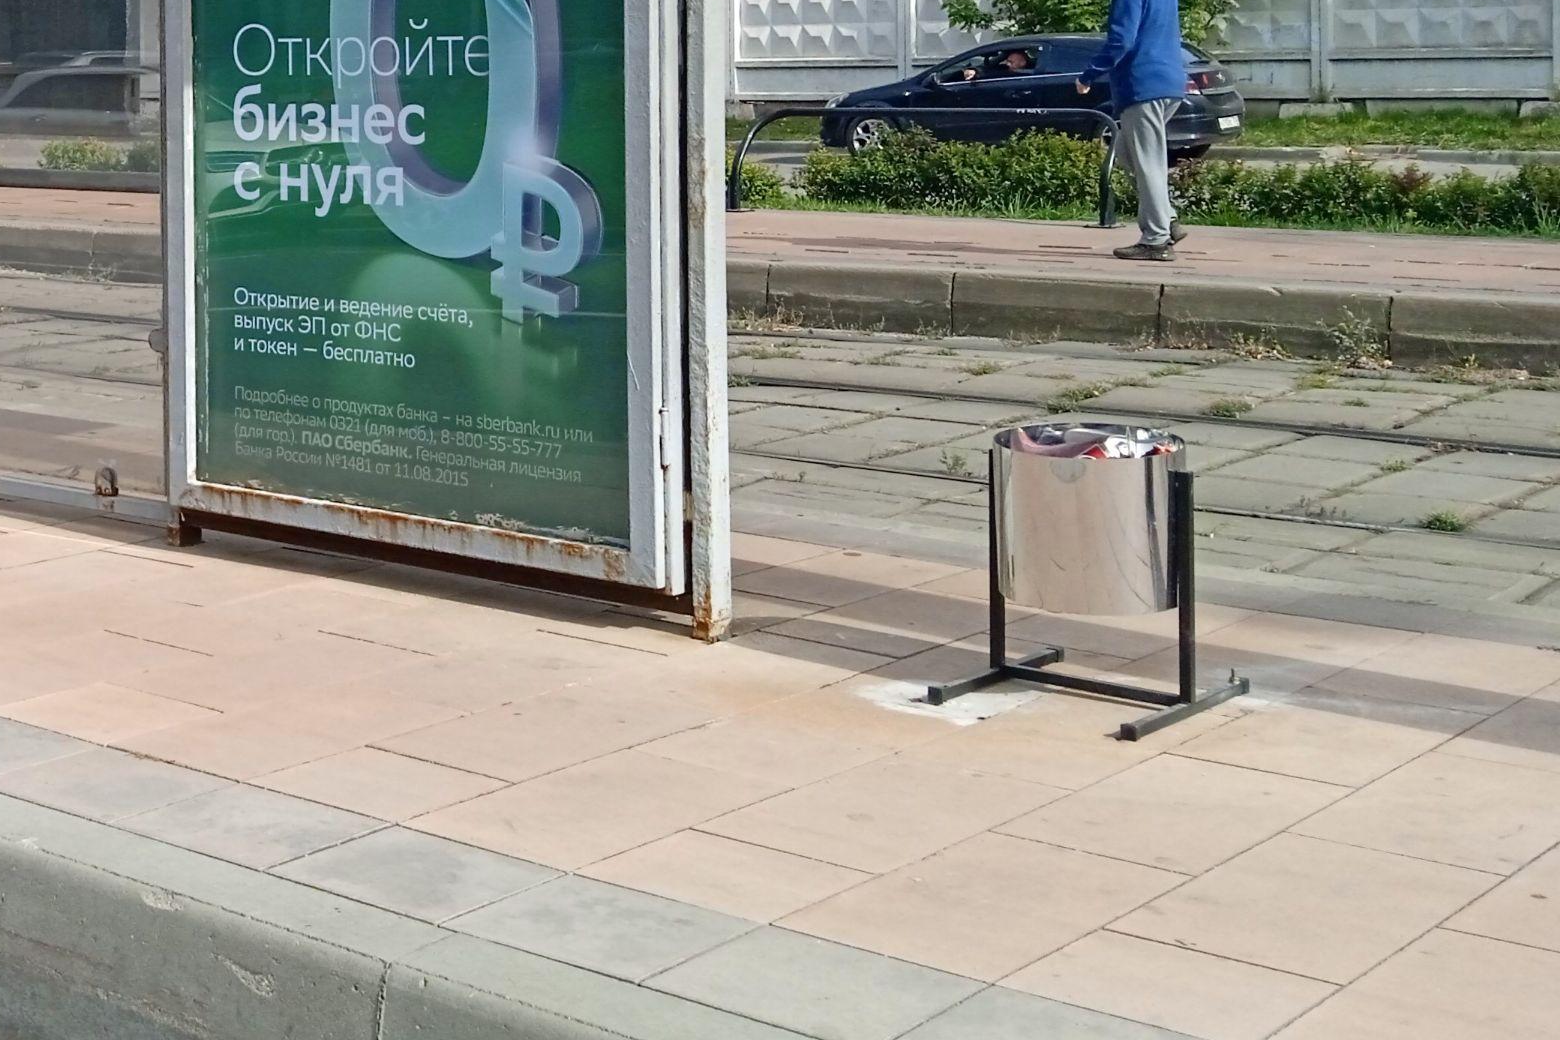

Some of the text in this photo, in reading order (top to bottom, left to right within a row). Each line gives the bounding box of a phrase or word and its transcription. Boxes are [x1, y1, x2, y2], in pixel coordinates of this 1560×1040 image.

[233, 18, 491, 88] Откройте
[233, 84, 425, 145] бизнес
[233, 162, 404, 218] с нуля
[234, 287, 473, 328] Открытие и ведение счёта,
[234, 314, 402, 342] выпуск ЭП от ФНС
[234, 337, 244, 351] и
[248, 338, 297, 356] токен
[323, 340, 416, 368] бесплатно
[234, 386, 309, 408] Подробнее
[312, 396, 321, 409] о
[324, 398, 394, 418] продуктах
[397, 403, 438, 423] банка
[455, 414, 473, 428] на
[476, 413, 560, 439] sberbank.ru
[564, 428, 594, 443] или
[234, 407, 251, 420] по
[253, 408, 327, 428] телефонам
[329, 415, 360, 433] 0321
[364, 419, 395, 438] (для
[440, 429, 562, 458] 8-800-55-55-777
[234, 422, 263, 440] (для
[301, 430, 333, 448] ПАО
[335, 435, 413, 459] Сбербанк.
[416, 446, 506, 472] Генеральная
[509, 462, 582, 483] лицензия
[235, 441, 469, 487] Банка России №1481 от 11.08.2015
